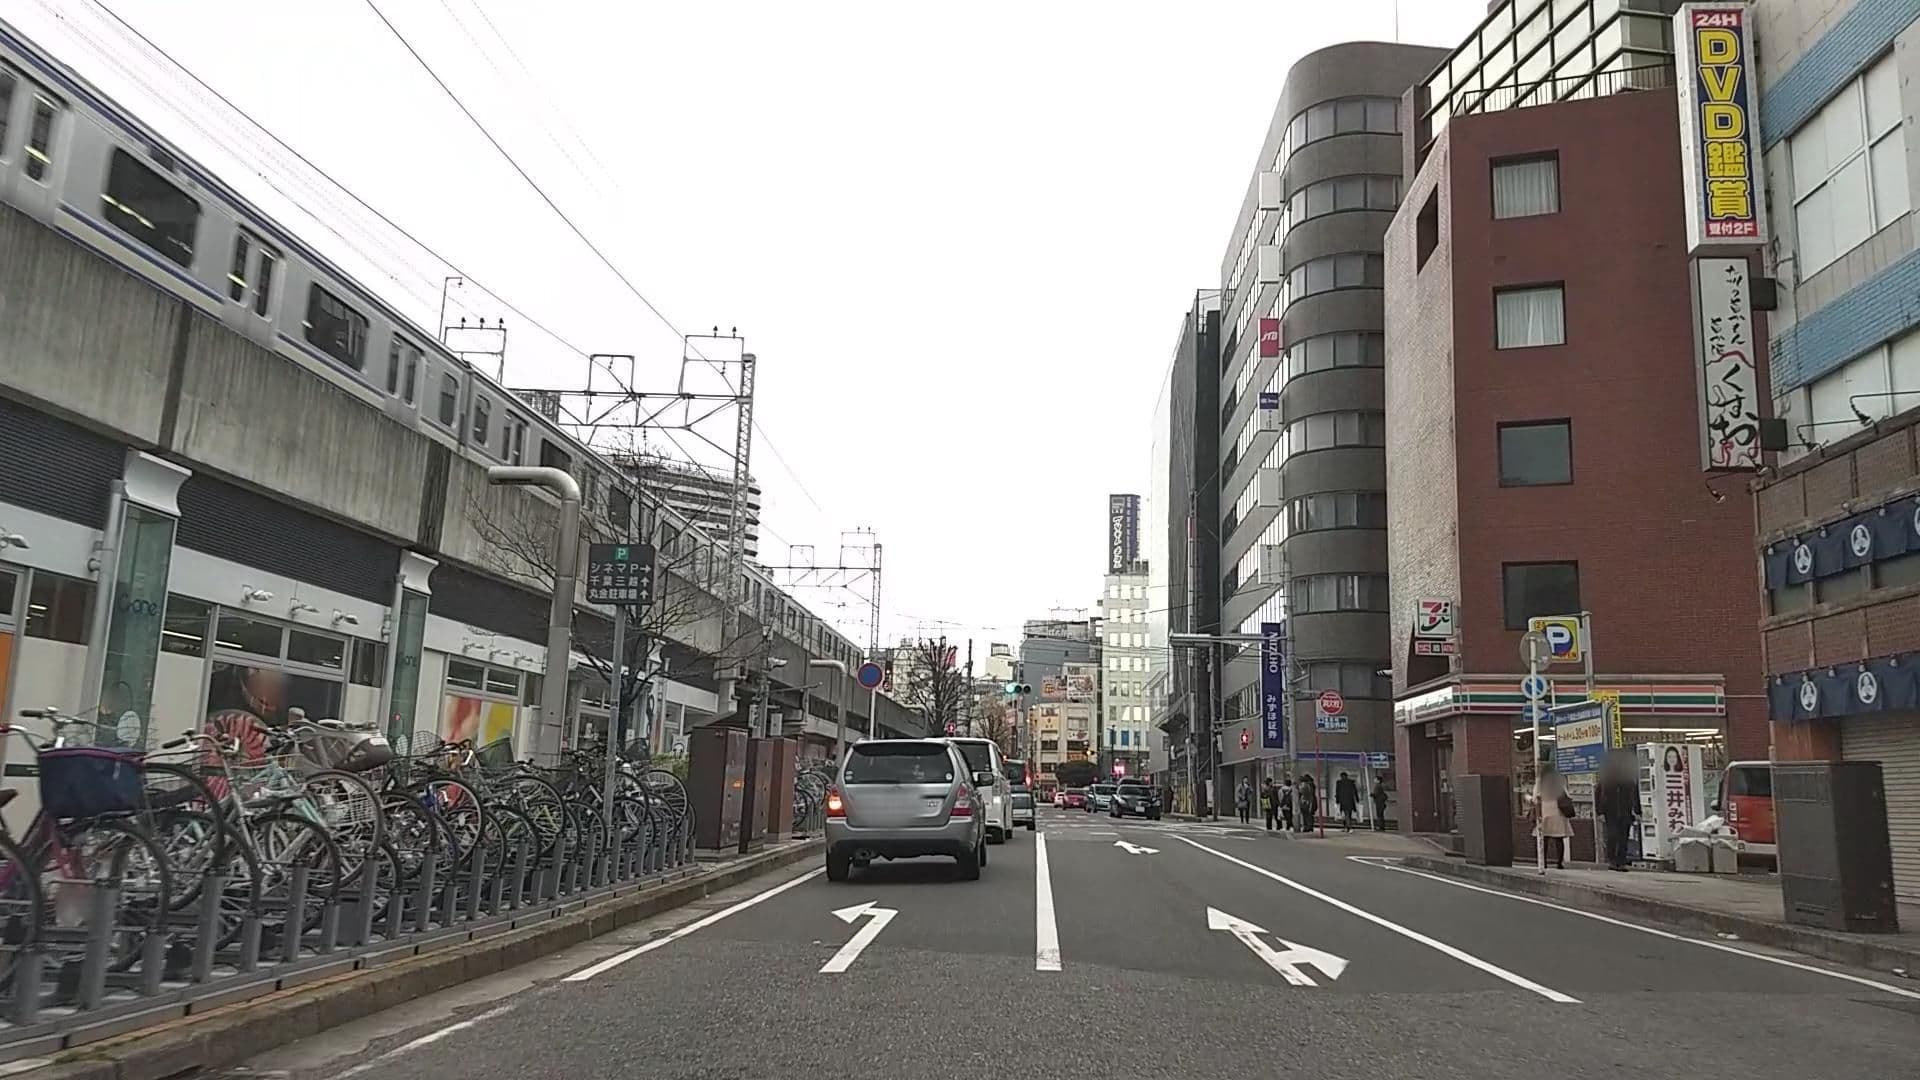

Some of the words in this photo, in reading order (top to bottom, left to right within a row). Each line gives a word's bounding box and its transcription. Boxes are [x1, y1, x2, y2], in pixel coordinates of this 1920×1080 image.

[1695, 14, 1738, 27] 24H
[1698, 28, 1751, 219] DVD鑑賞
[1261, 331, 1278, 342] JTB
[617, 547, 627, 559] P
[591, 562, 639, 574] シネマP
[590, 576, 638, 587] 千葉三越
[1546, 626, 1571, 653] P
[1266, 694, 1278, 740] みずほ証券
[1665, 774, 1685, 833] 三井みわ
